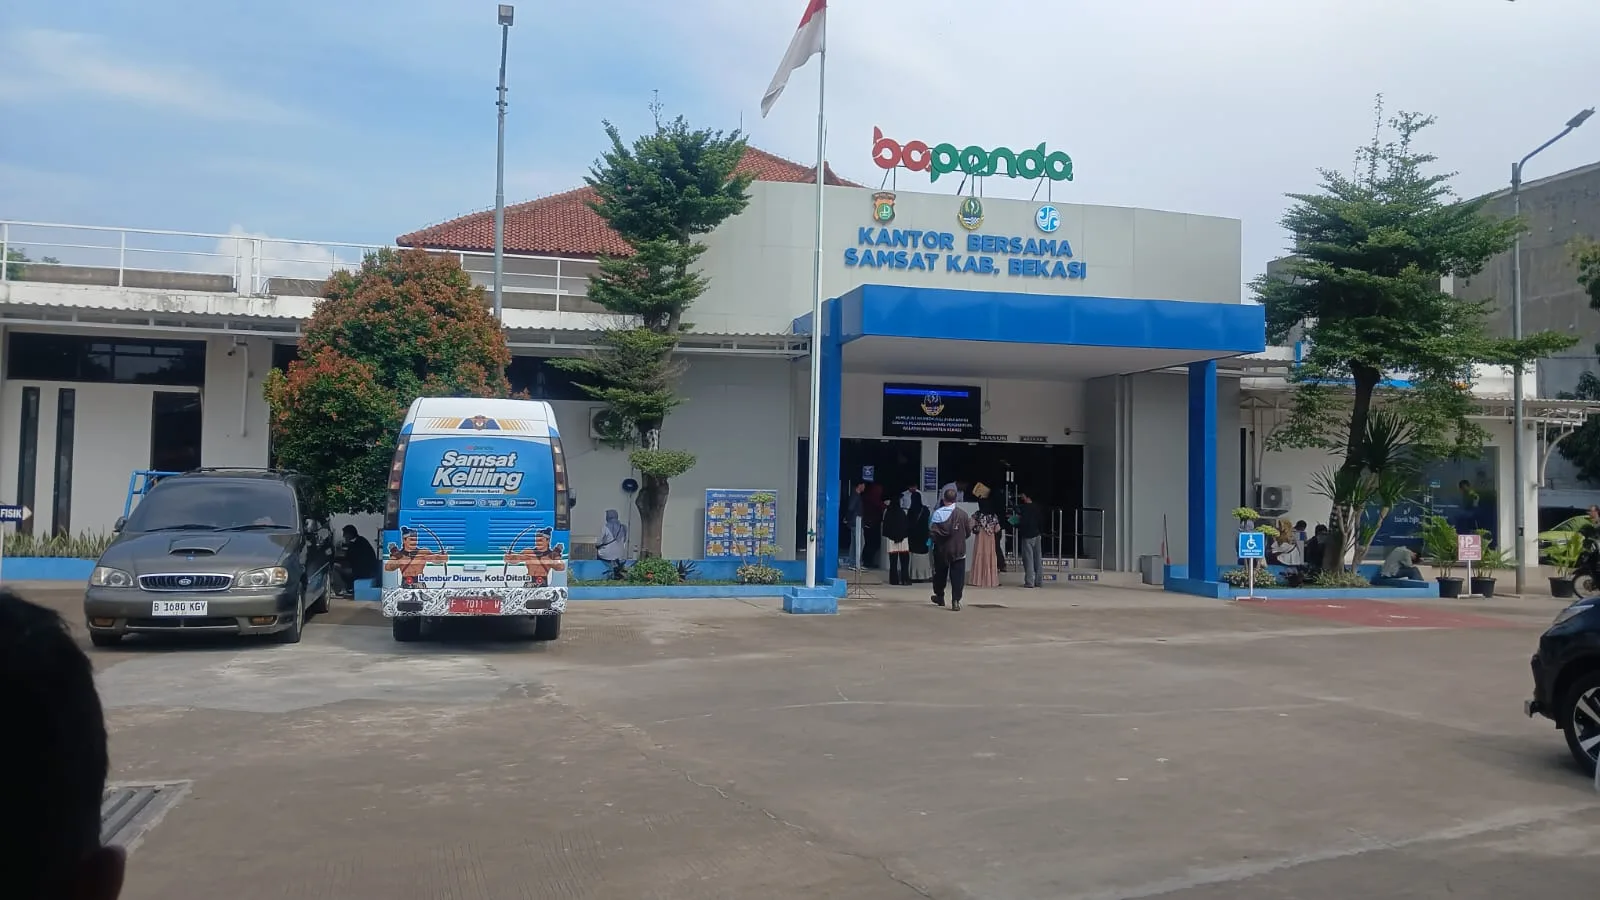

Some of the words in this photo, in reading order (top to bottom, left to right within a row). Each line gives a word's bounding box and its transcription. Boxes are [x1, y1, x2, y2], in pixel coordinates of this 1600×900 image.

[858, 227, 954, 251] KANTOR
[967, 234, 1073, 258] BERSAMA
[844, 248, 939, 272] SAMSAT
[946, 255, 1000, 275] KAB.
[1008, 258, 1087, 280] BEKASI
[441, 450, 517, 468] Samsat
[431, 466, 524, 491] Keliling
[0, 508, 22, 518] FISIK
[419, 574, 452, 582] Lembur
[453, 574, 482, 583] Diurus,
[154, 602, 160, 611] B
[190, 602, 206, 611] KGY
